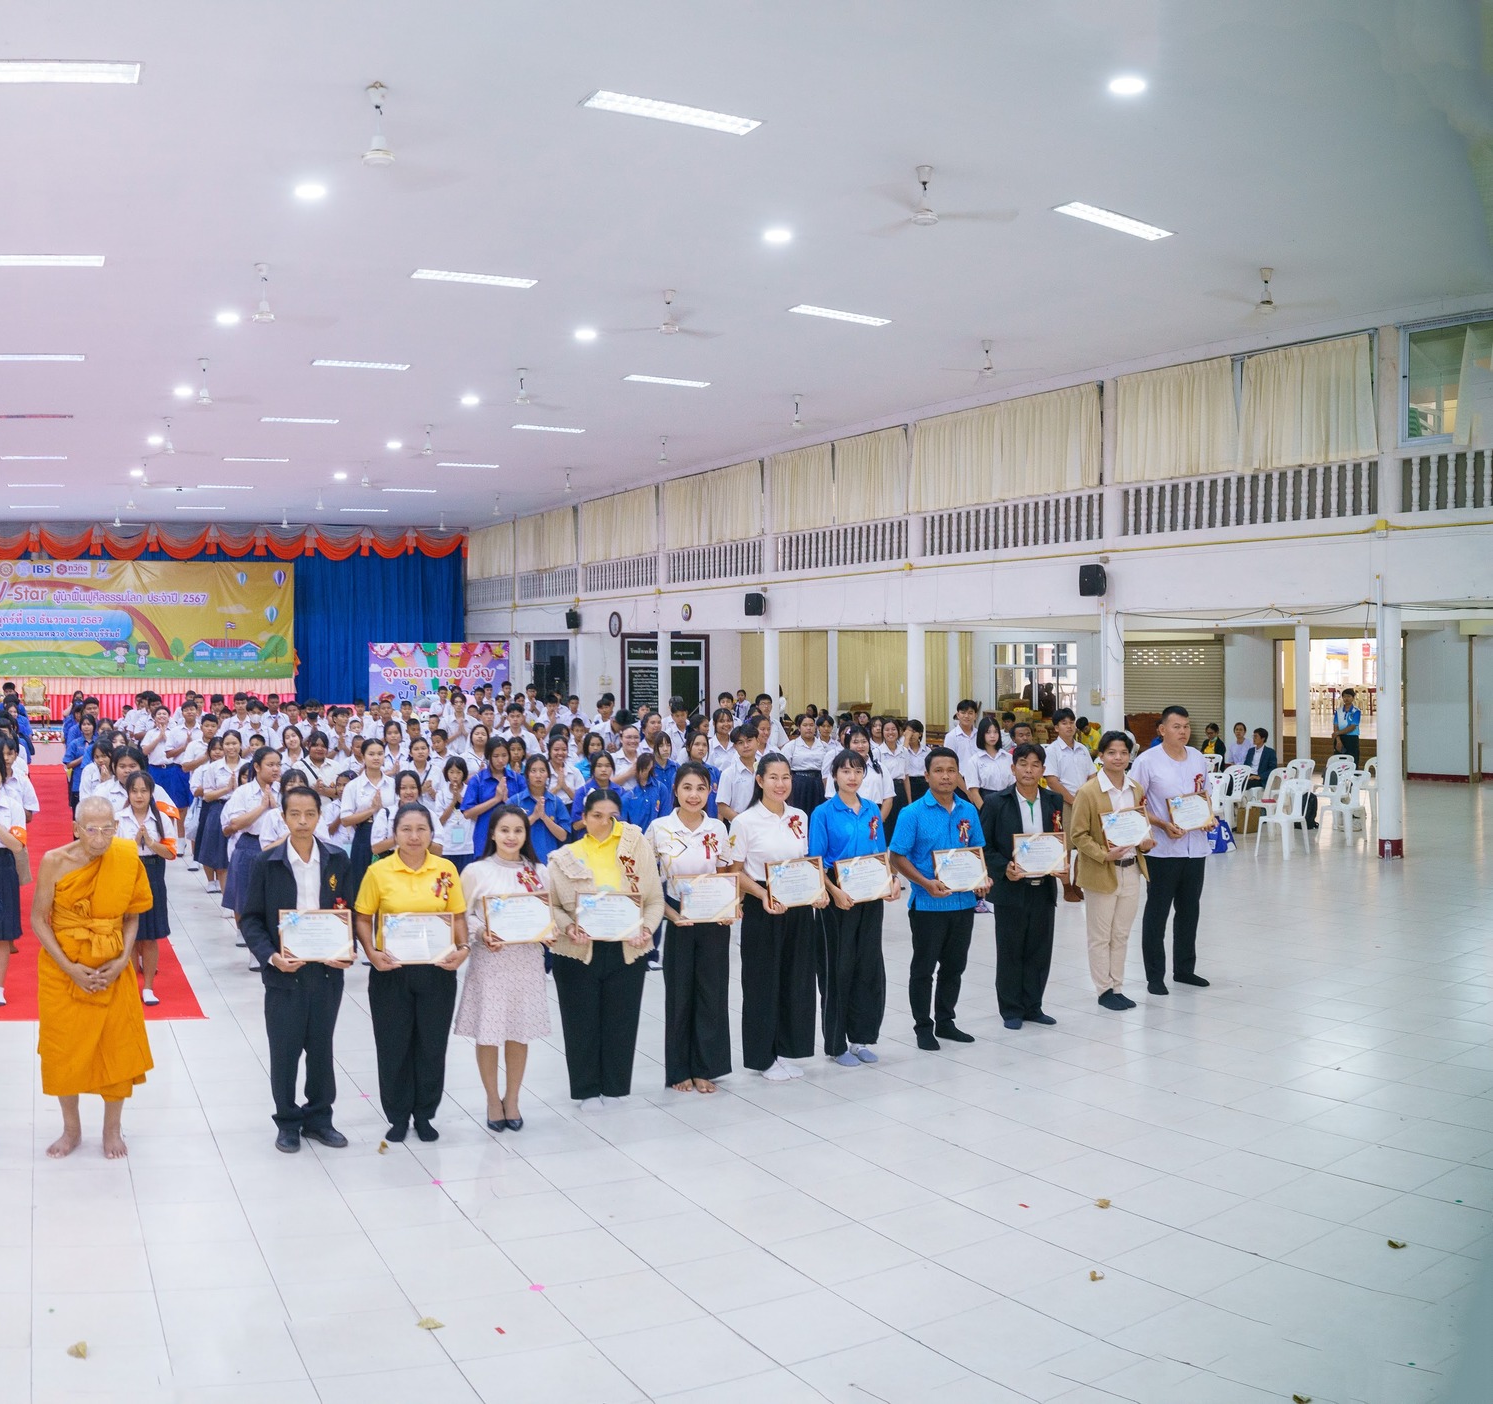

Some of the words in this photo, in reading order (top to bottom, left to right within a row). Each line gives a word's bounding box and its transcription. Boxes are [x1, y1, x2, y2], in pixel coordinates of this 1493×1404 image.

[32, 564, 52, 574] IBS
[147, 592, 178, 603] ประจำปี
[183, 594, 207, 603] 2567
[26, 616, 36, 624] 13
[39, 615, 78, 624] ธันวาคม
[80, 616, 104, 624] 2567
[382, 664, 495, 682] จุดแจกของขวัญ
